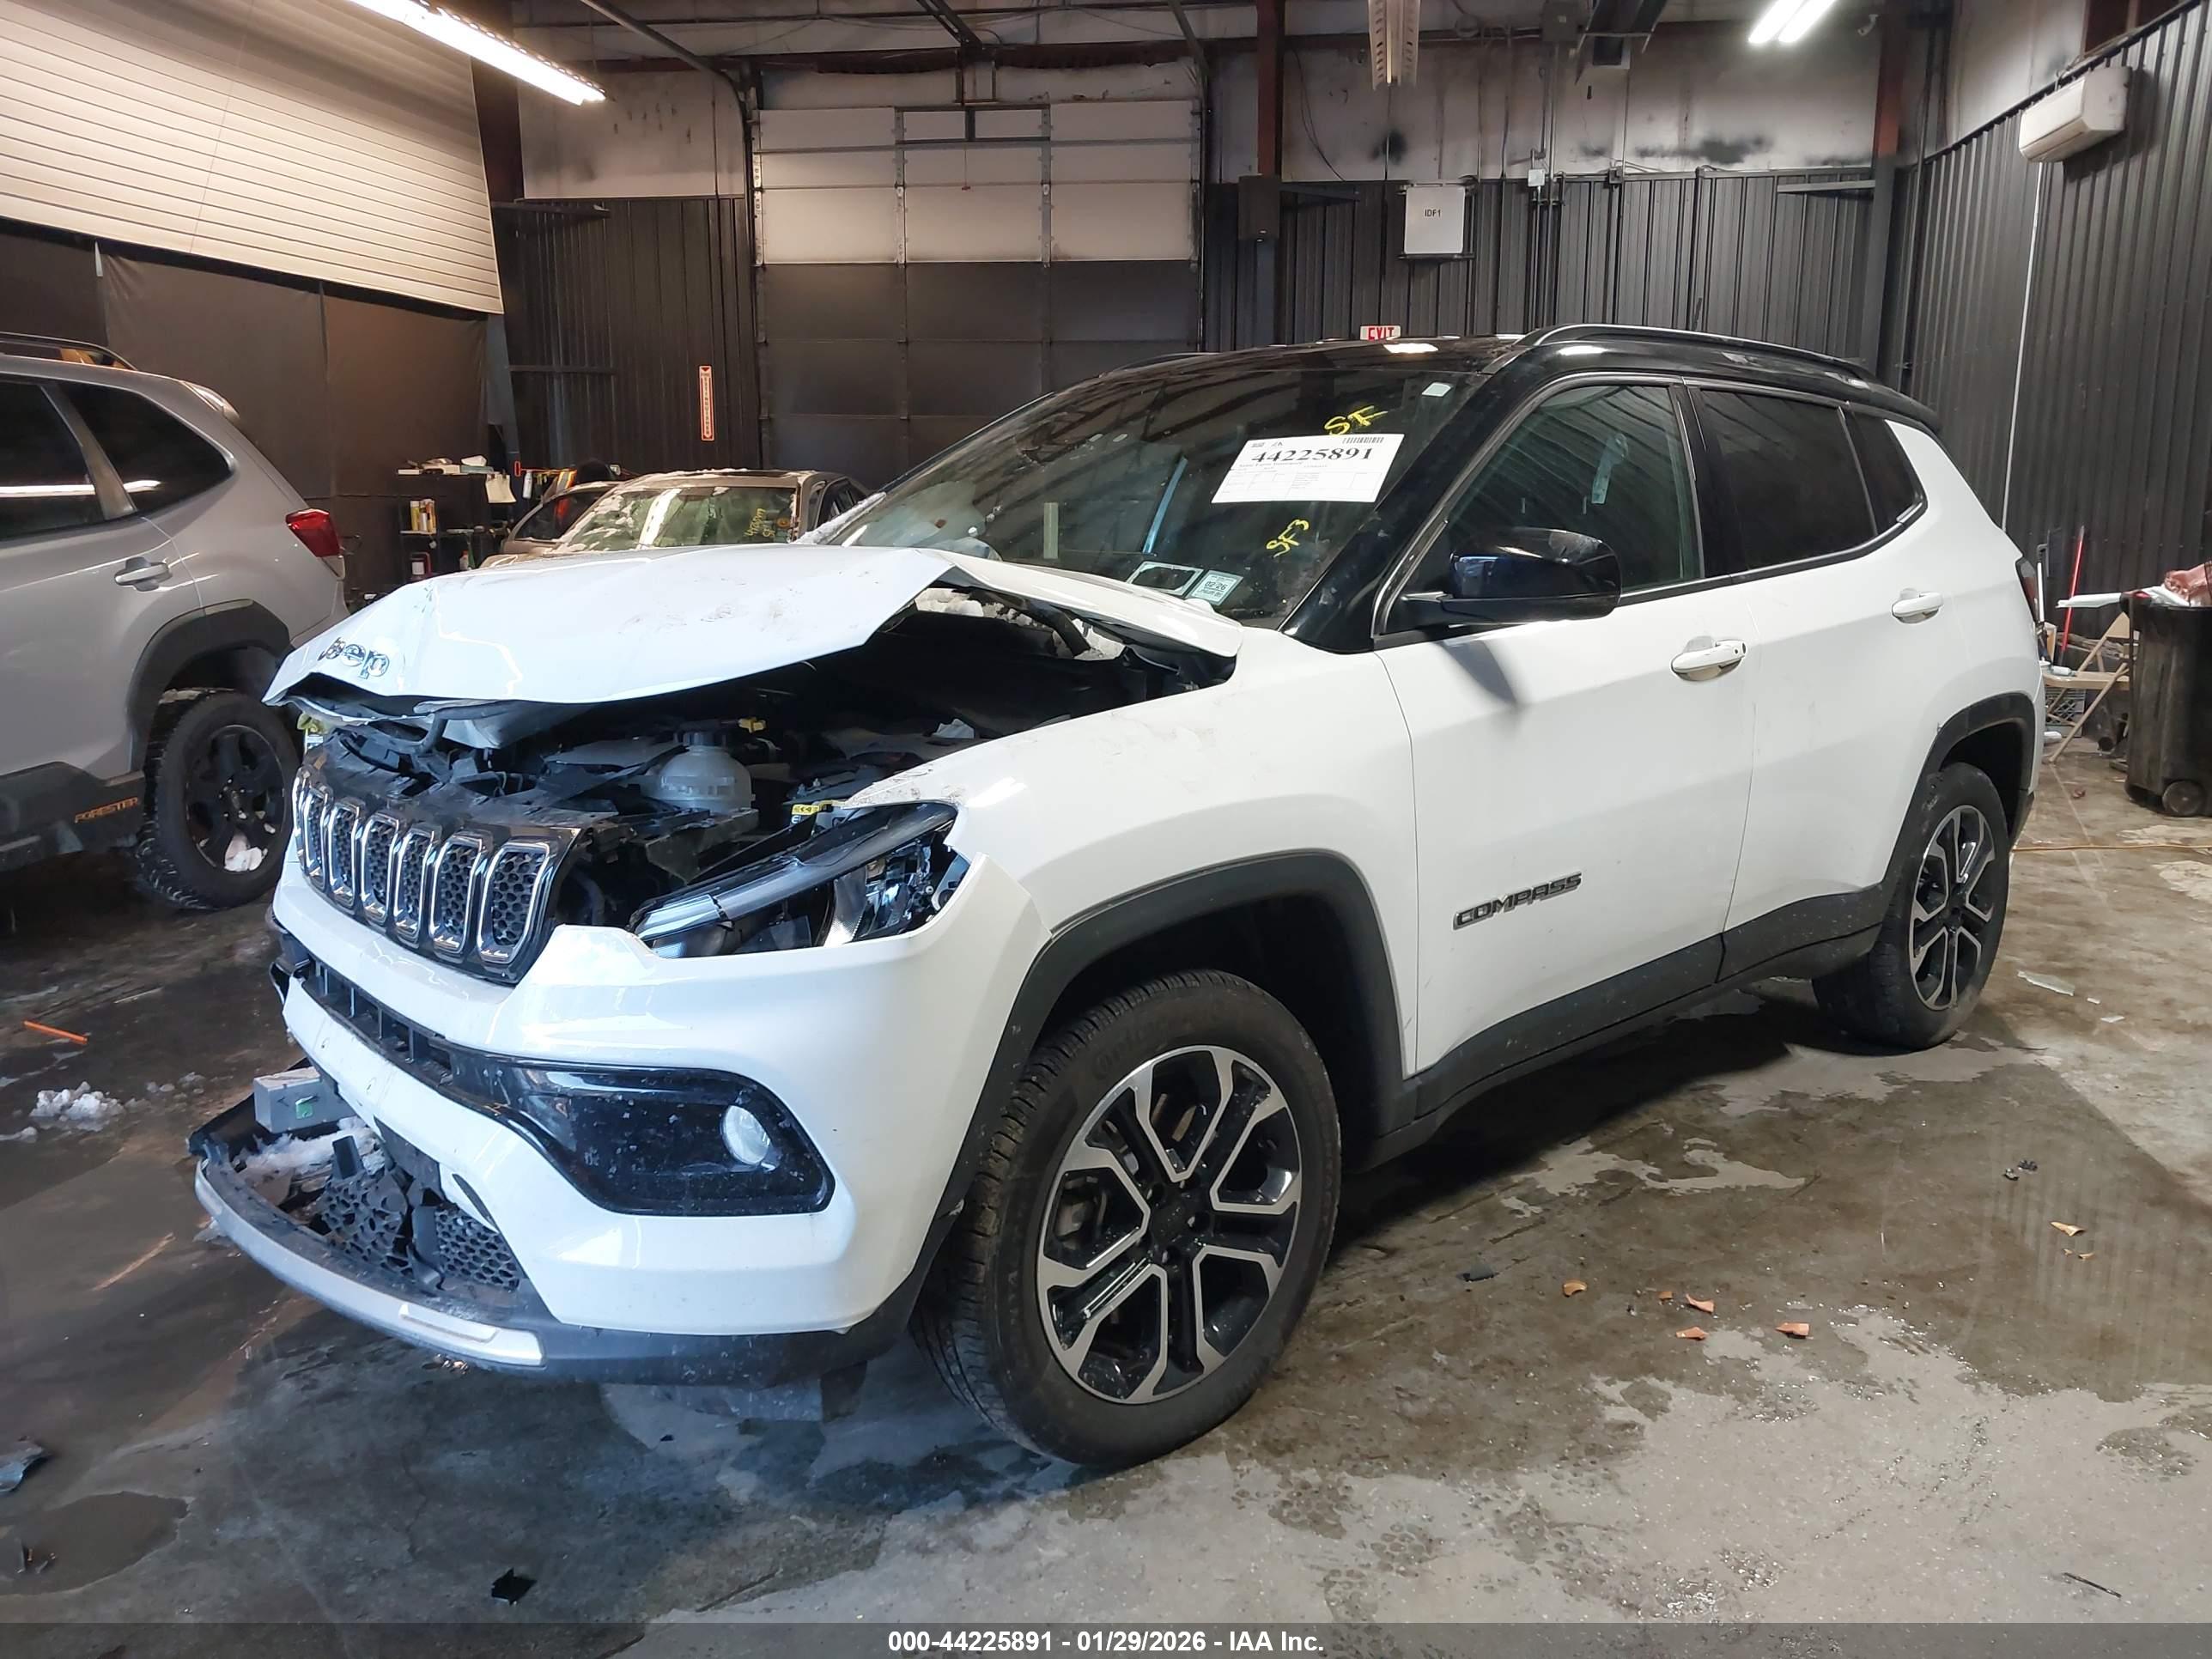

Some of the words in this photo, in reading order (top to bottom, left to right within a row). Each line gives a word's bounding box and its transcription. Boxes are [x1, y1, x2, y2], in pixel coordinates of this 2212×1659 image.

[1424, 209, 1442, 217] IDF1
[1251, 447, 1374, 463] 44225891
[75, 797, 137, 823] FORESTER
[1453, 872, 1583, 931] COMPASS
